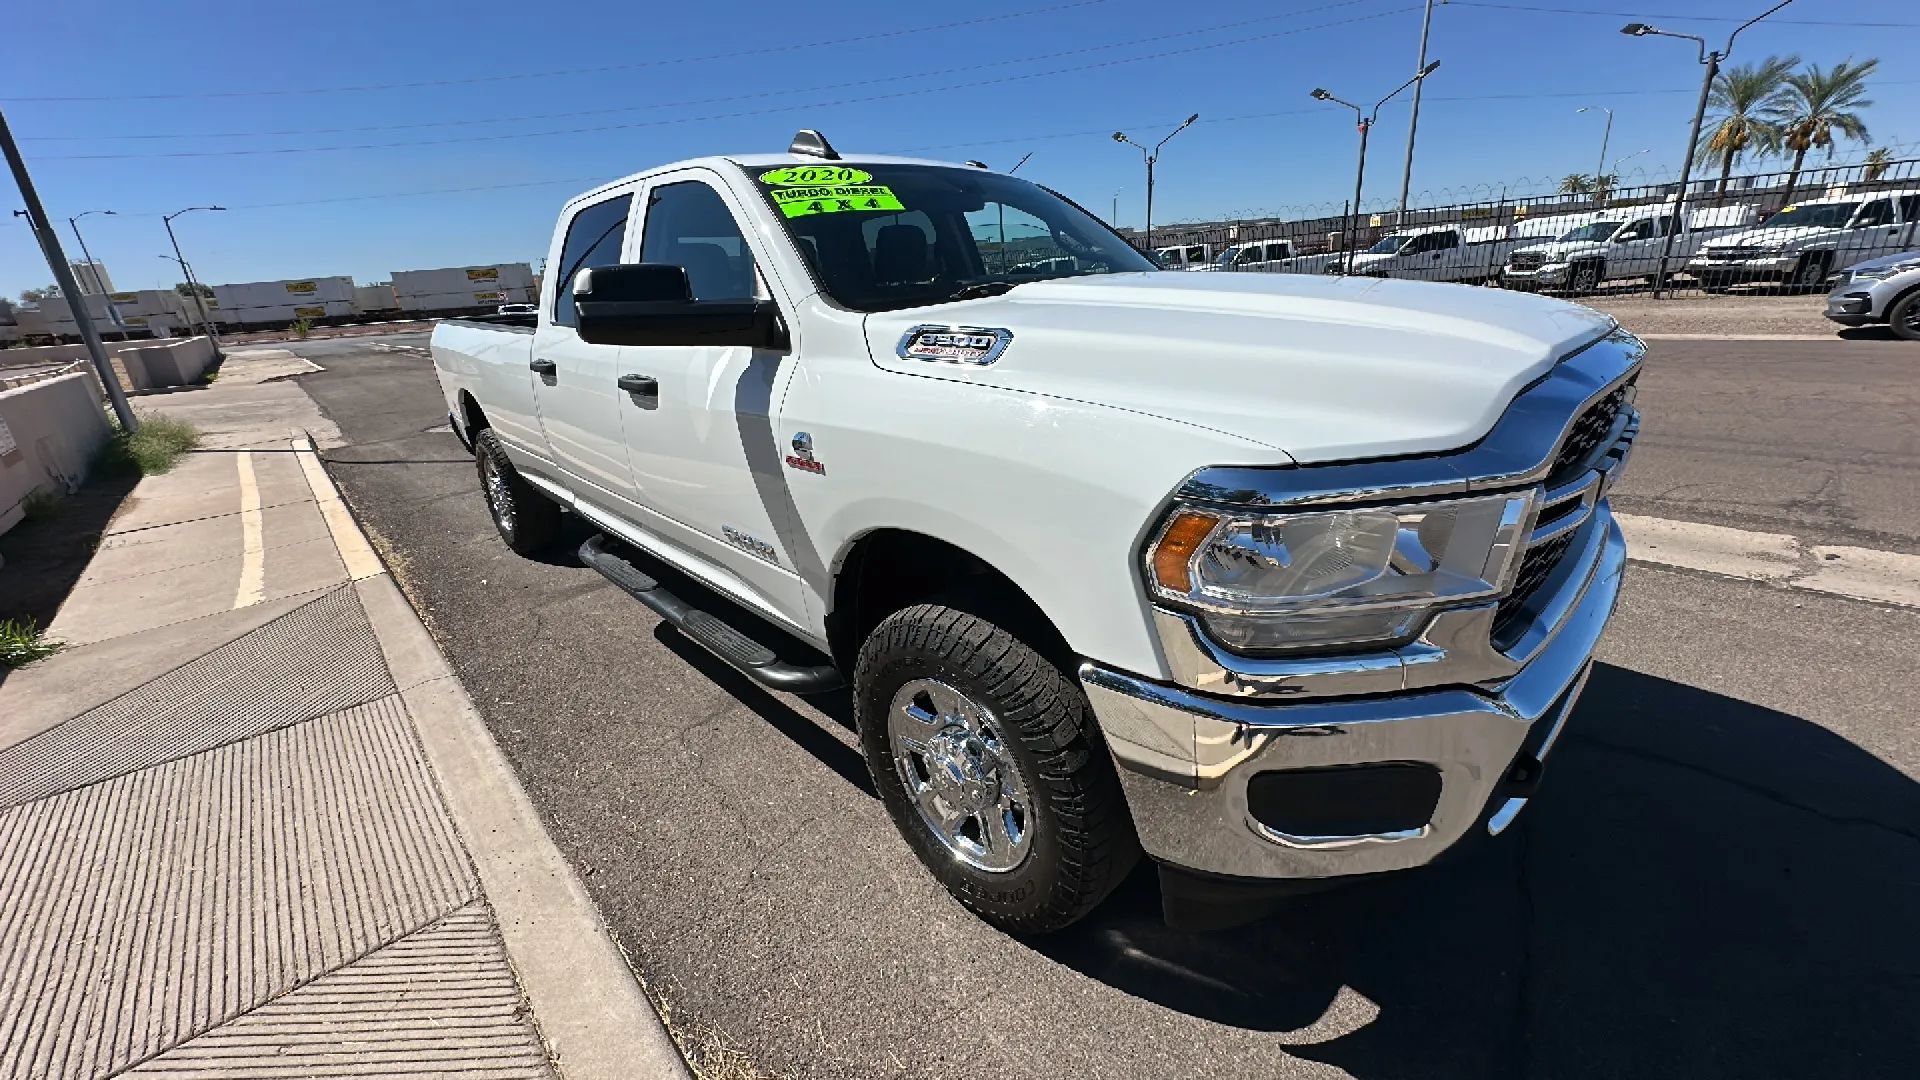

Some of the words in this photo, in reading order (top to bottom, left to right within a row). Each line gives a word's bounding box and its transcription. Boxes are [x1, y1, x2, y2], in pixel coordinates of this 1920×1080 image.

[783, 169, 853, 183] 2020
[834, 187, 887, 197] DIESEL
[807, 201, 824, 212] 4
[864, 198, 880, 208] 4
